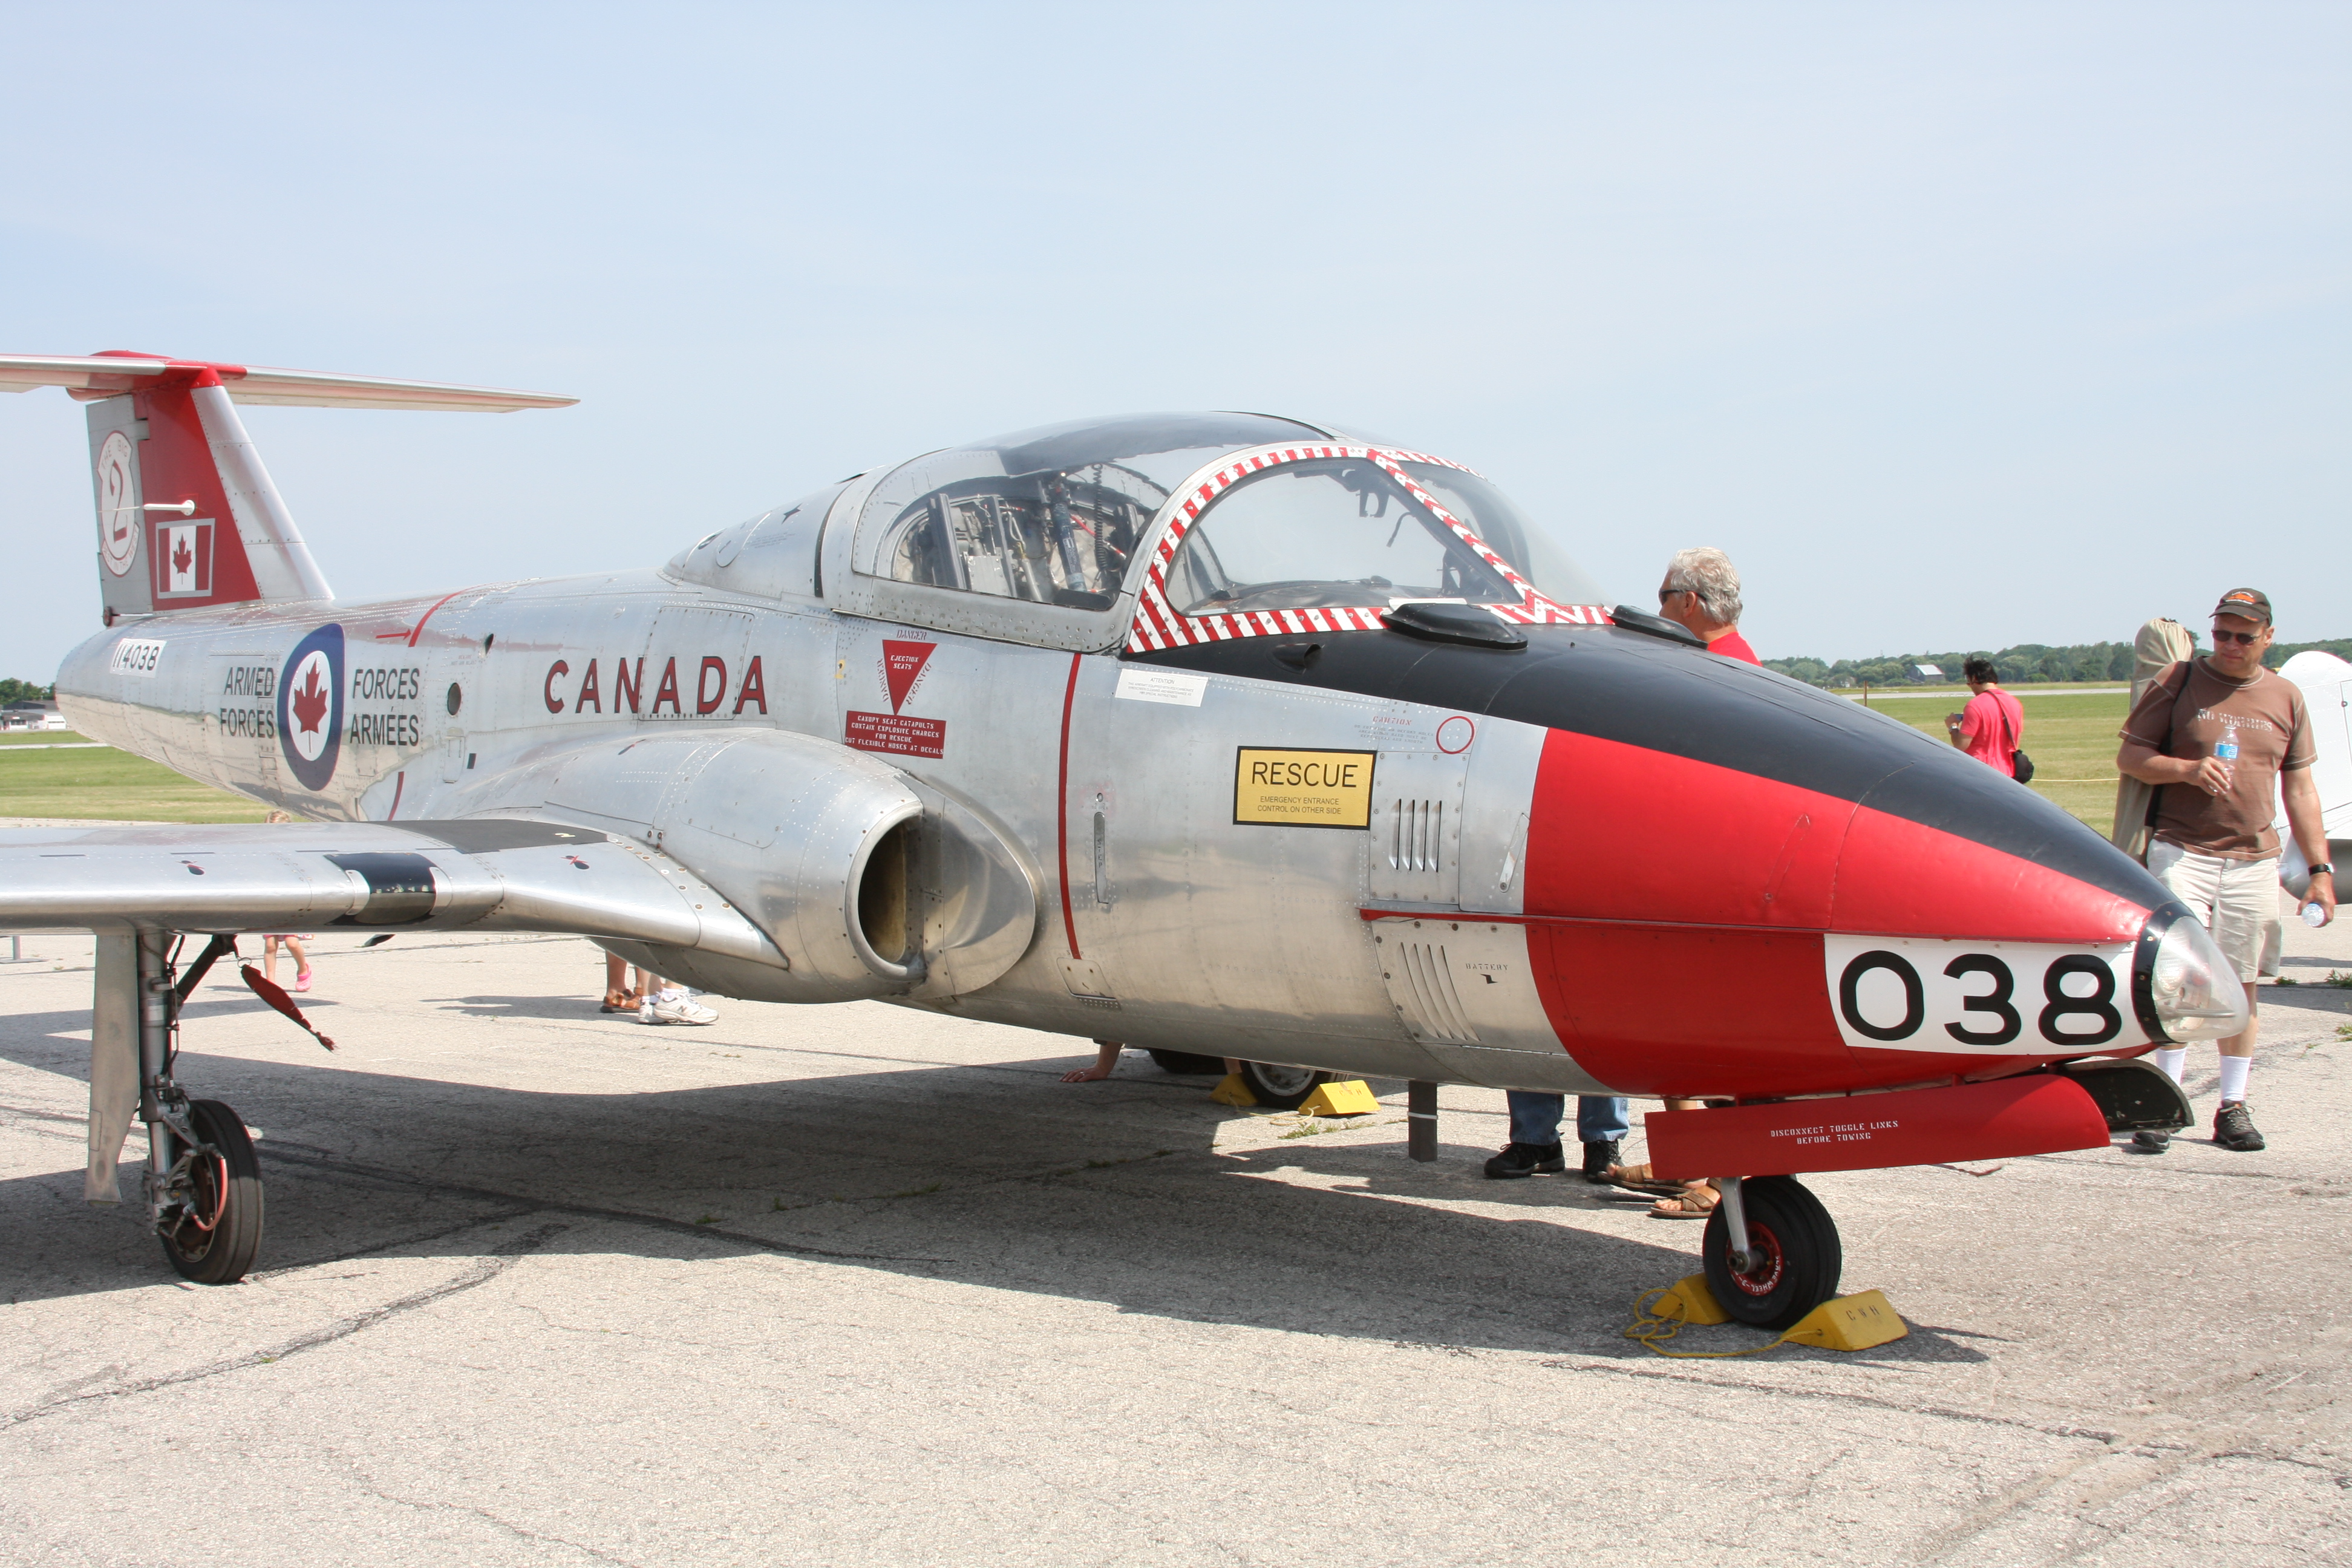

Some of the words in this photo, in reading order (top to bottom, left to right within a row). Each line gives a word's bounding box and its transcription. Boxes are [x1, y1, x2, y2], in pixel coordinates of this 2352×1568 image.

[109, 459, 128, 543] 2
[896, 629, 927, 641] DANGER
[112, 644, 160, 671] 114038
[224, 667, 274, 696] ARMED
[353, 668, 420, 700] FORCES
[544, 656, 767, 715] CANADA
[220, 708, 275, 739] FORCES
[350, 706, 419, 746] ARMÉES
[878, 725, 909, 734] EXPLOSIVE
[912, 729, 939, 738] CHARGES
[900, 720, 935, 729] CATAPULTS
[1372, 716, 1412, 725] CAUTION
[858, 738, 885, 748] FLEXIBLE
[1252, 761, 1359, 788] RESCUE
[1257, 805, 1288, 813] CONTROL
[1260, 795, 1301, 804] EMERGENCY
[1840, 950, 2122, 1046] 038
[1771, 1126, 1824, 1137] DISCONNECT
[1829, 1123, 1865, 1132] TOGGLE
[1870, 1120, 1898, 1130] LINKS
[1797, 1135, 1831, 1145] BEFORE
[1837, 1132, 1871, 1142] TOWING
